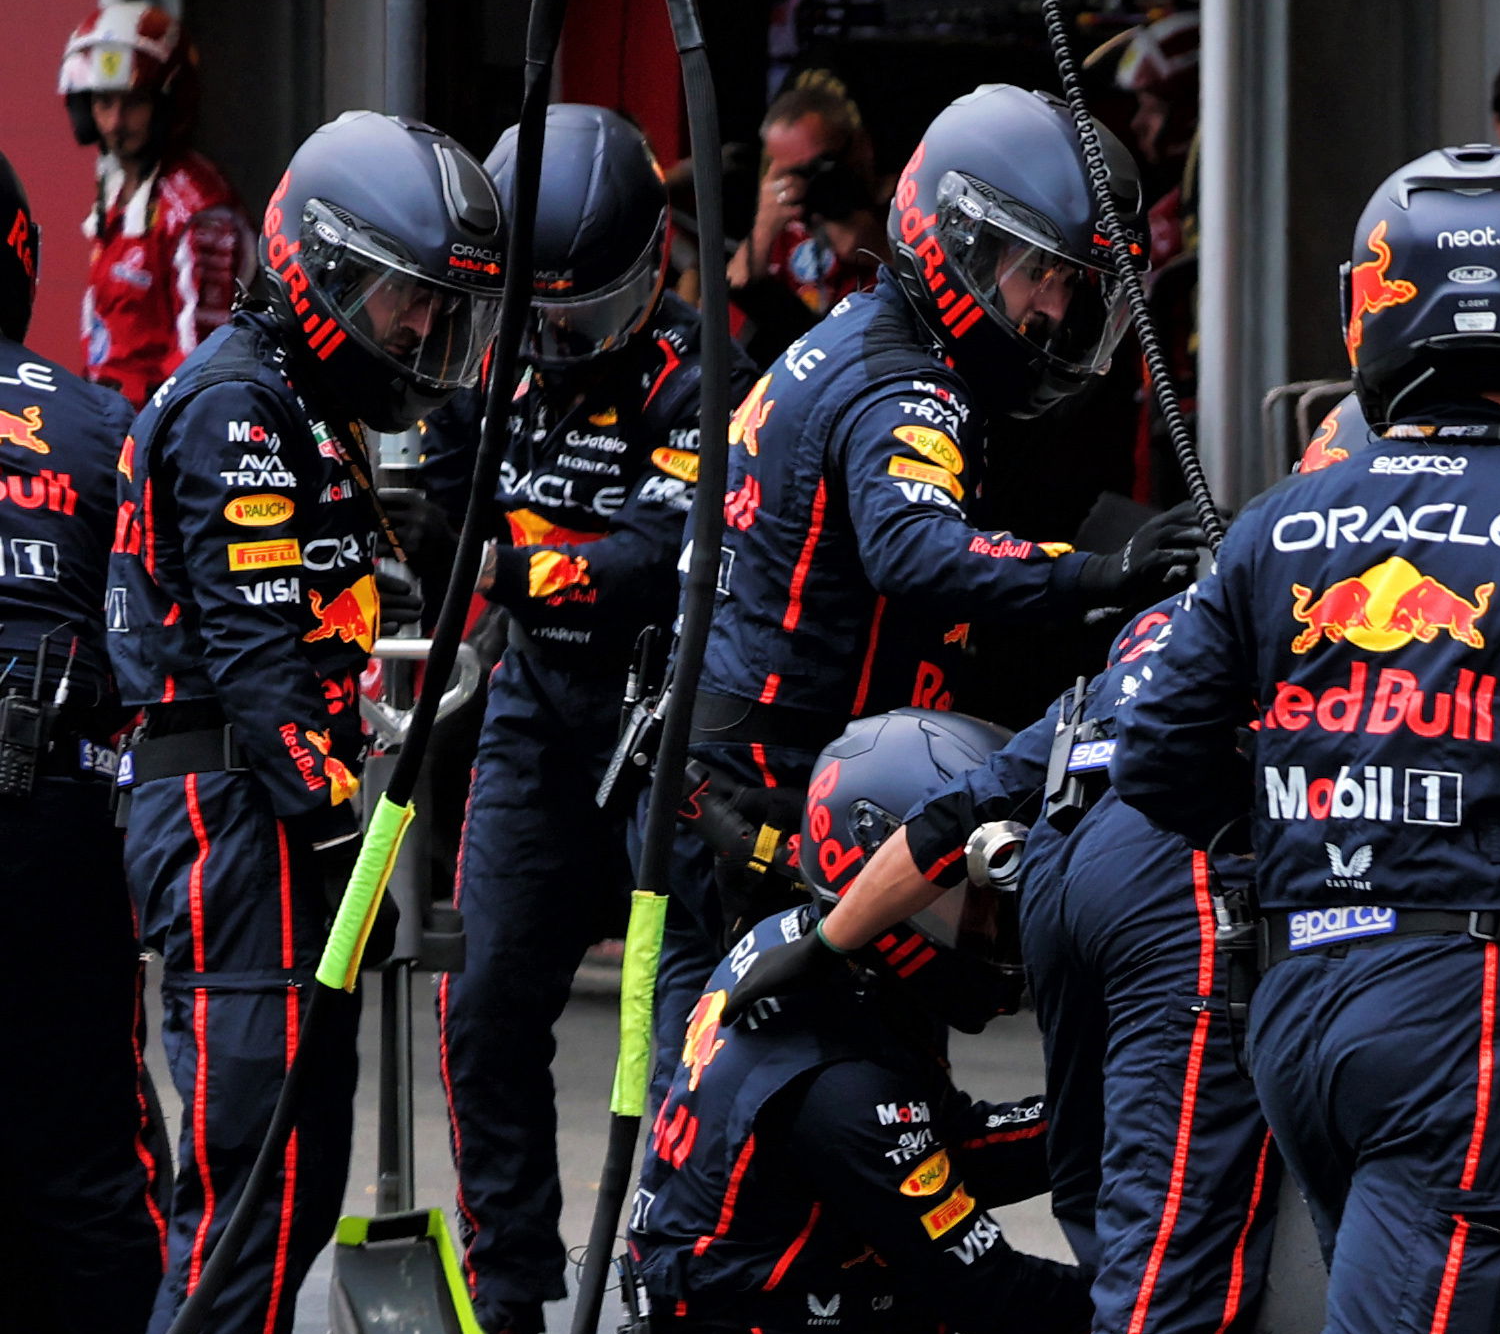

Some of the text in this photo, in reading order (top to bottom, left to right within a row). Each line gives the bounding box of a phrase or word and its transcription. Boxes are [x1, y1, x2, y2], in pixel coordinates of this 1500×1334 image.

[451, 243, 501, 261] ORACLE
[669, 429, 700, 450] RO
[917, 433, 957, 467] RAUCH
[238, 454, 285, 470] AVA
[1369, 453, 1469, 475] sparco
[0, 470, 79, 516] ull
[499, 461, 627, 517] RACLE
[243, 502, 287, 518] RAUCH
[236, 543, 298, 565] PIRELLI
[236, 578, 301, 605] VISA
[1364, 667, 1498, 743] Bull
[279, 722, 327, 792] Red Bull
[1264, 765, 1394, 822] Mobil
[807, 760, 865, 884] Red
[1289, 907, 1394, 946] sparco
[876, 1101, 931, 1126] Mobil
[945, 1212, 1001, 1266] VISA
